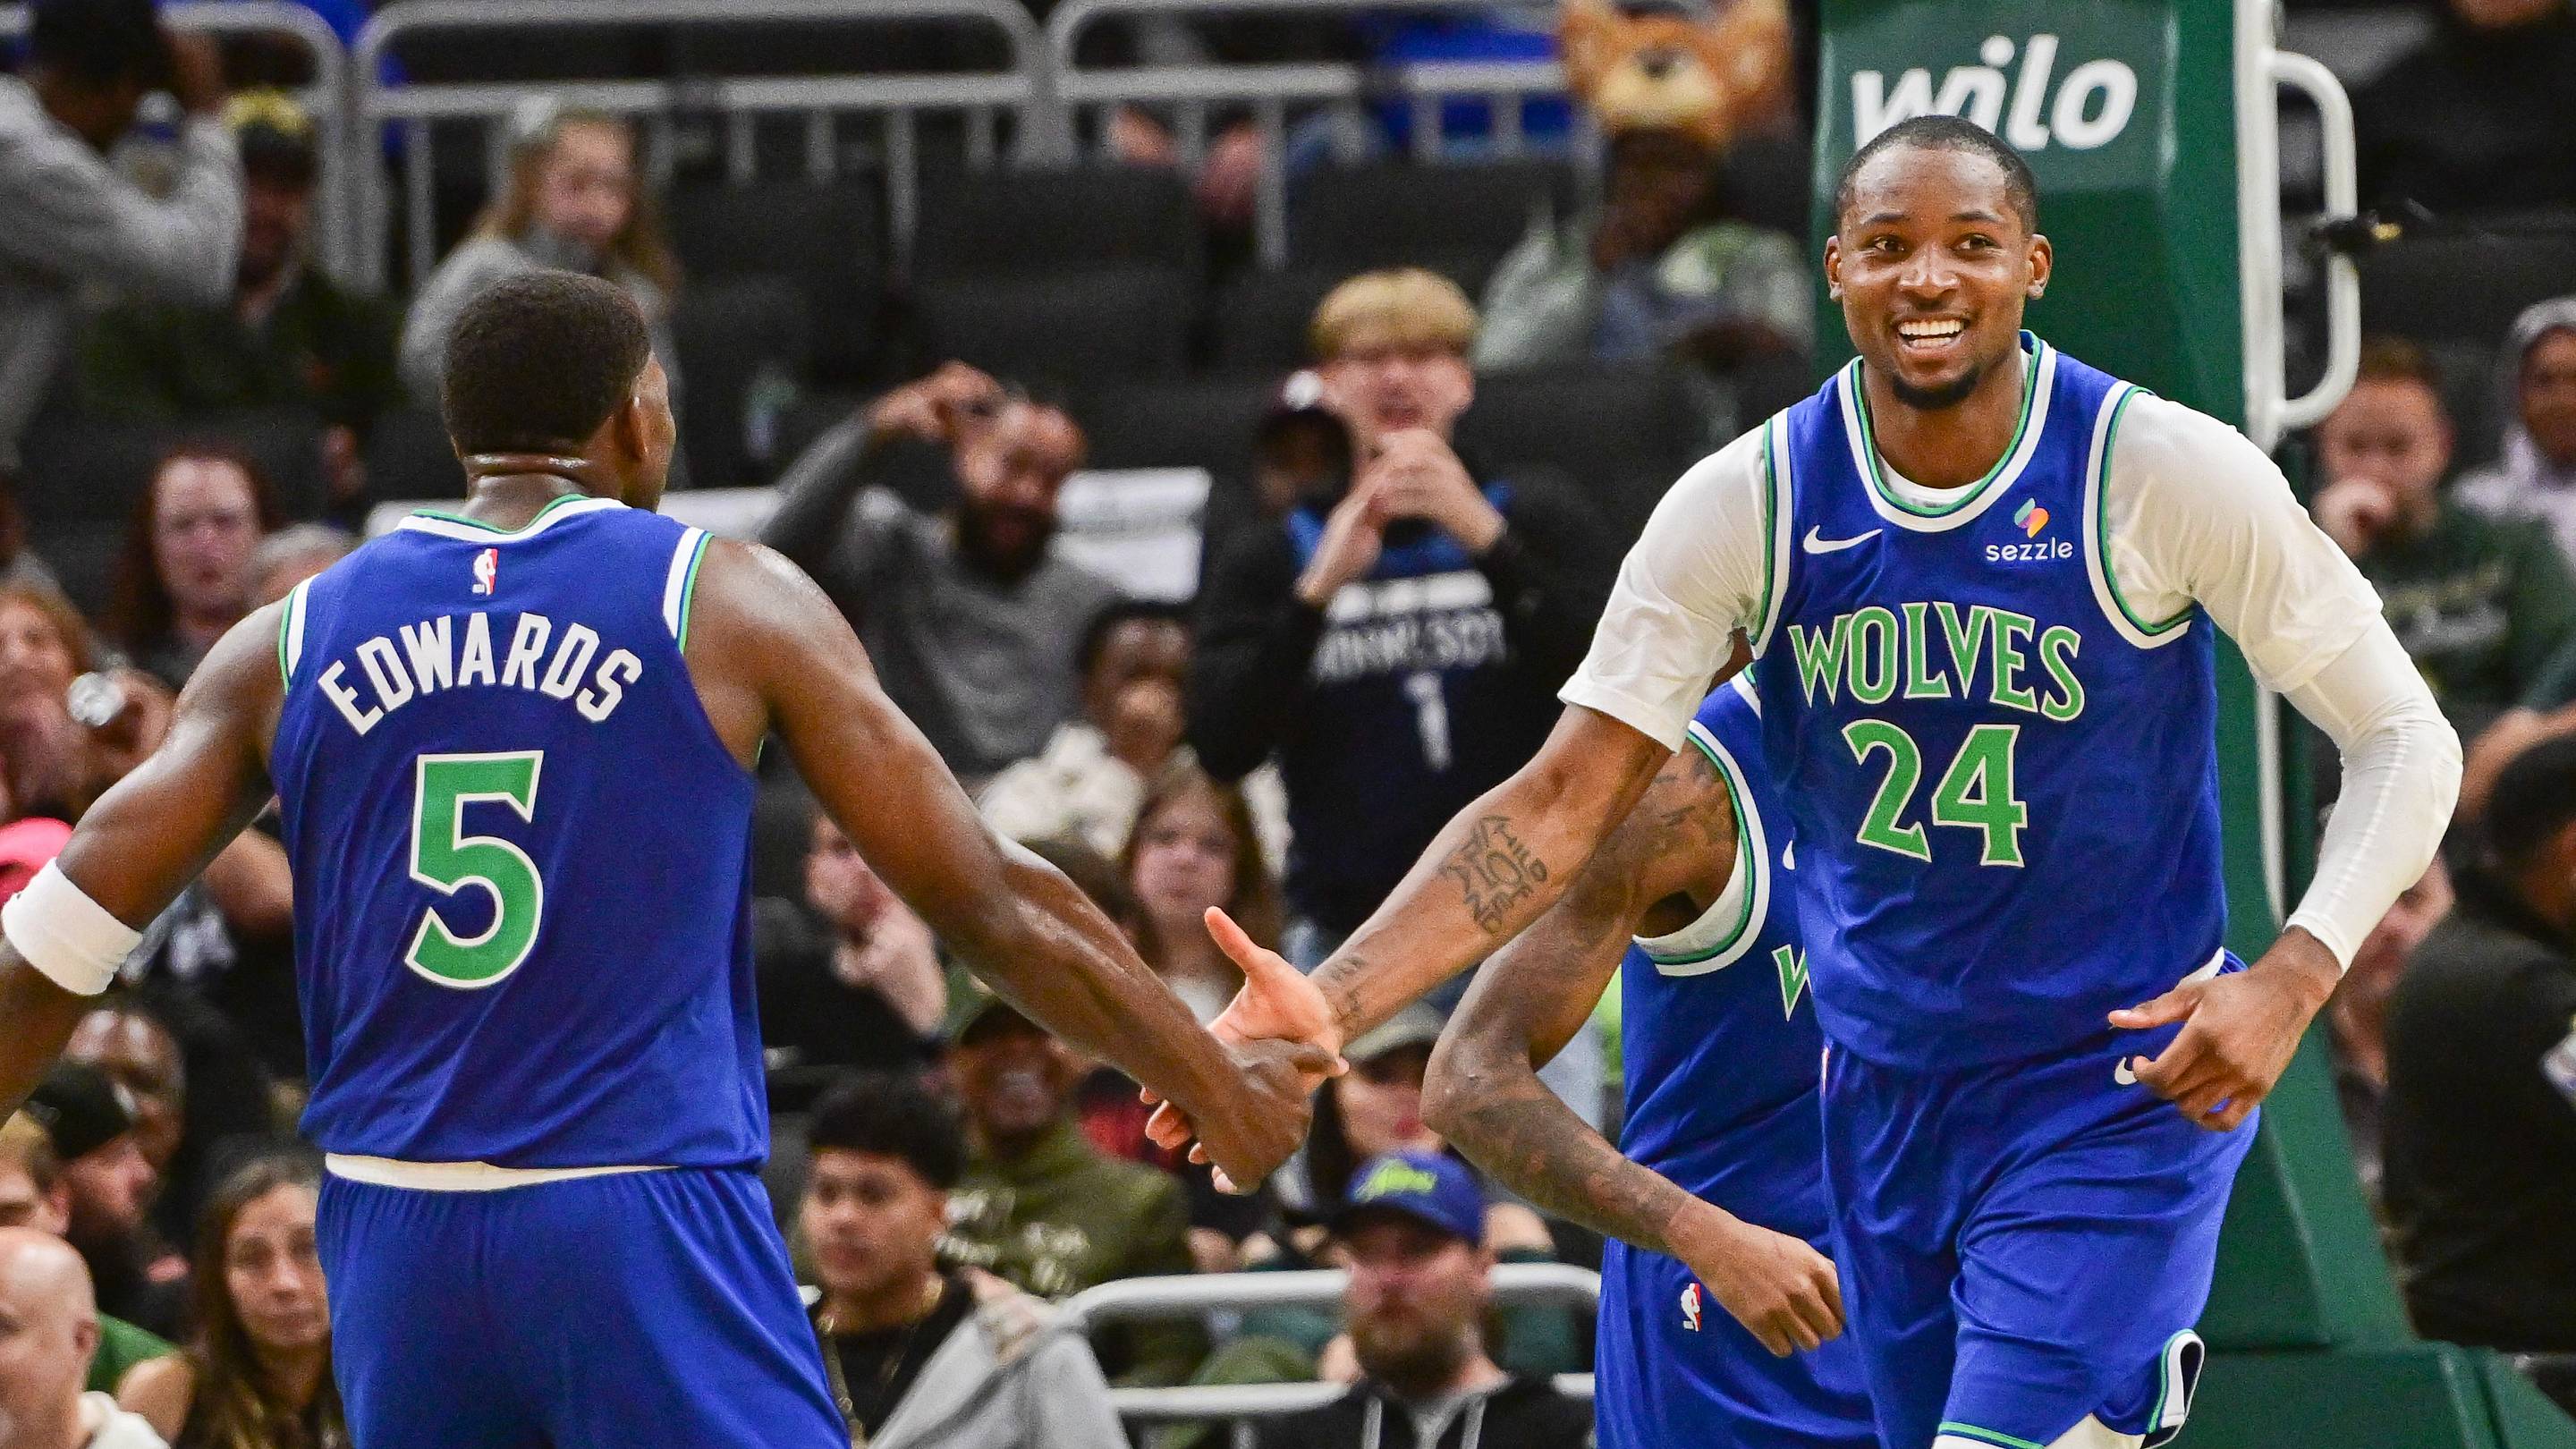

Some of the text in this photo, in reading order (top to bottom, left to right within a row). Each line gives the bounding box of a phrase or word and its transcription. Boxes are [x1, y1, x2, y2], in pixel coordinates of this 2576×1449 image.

[1852, 33, 2139, 150] wilo
[1986, 537, 2073, 562] sezzle
[318, 612, 643, 735] EDWARDS
[1788, 601, 2085, 722] WOLVES
[1833, 719, 2028, 868] 24
[404, 750, 544, 989] 5
